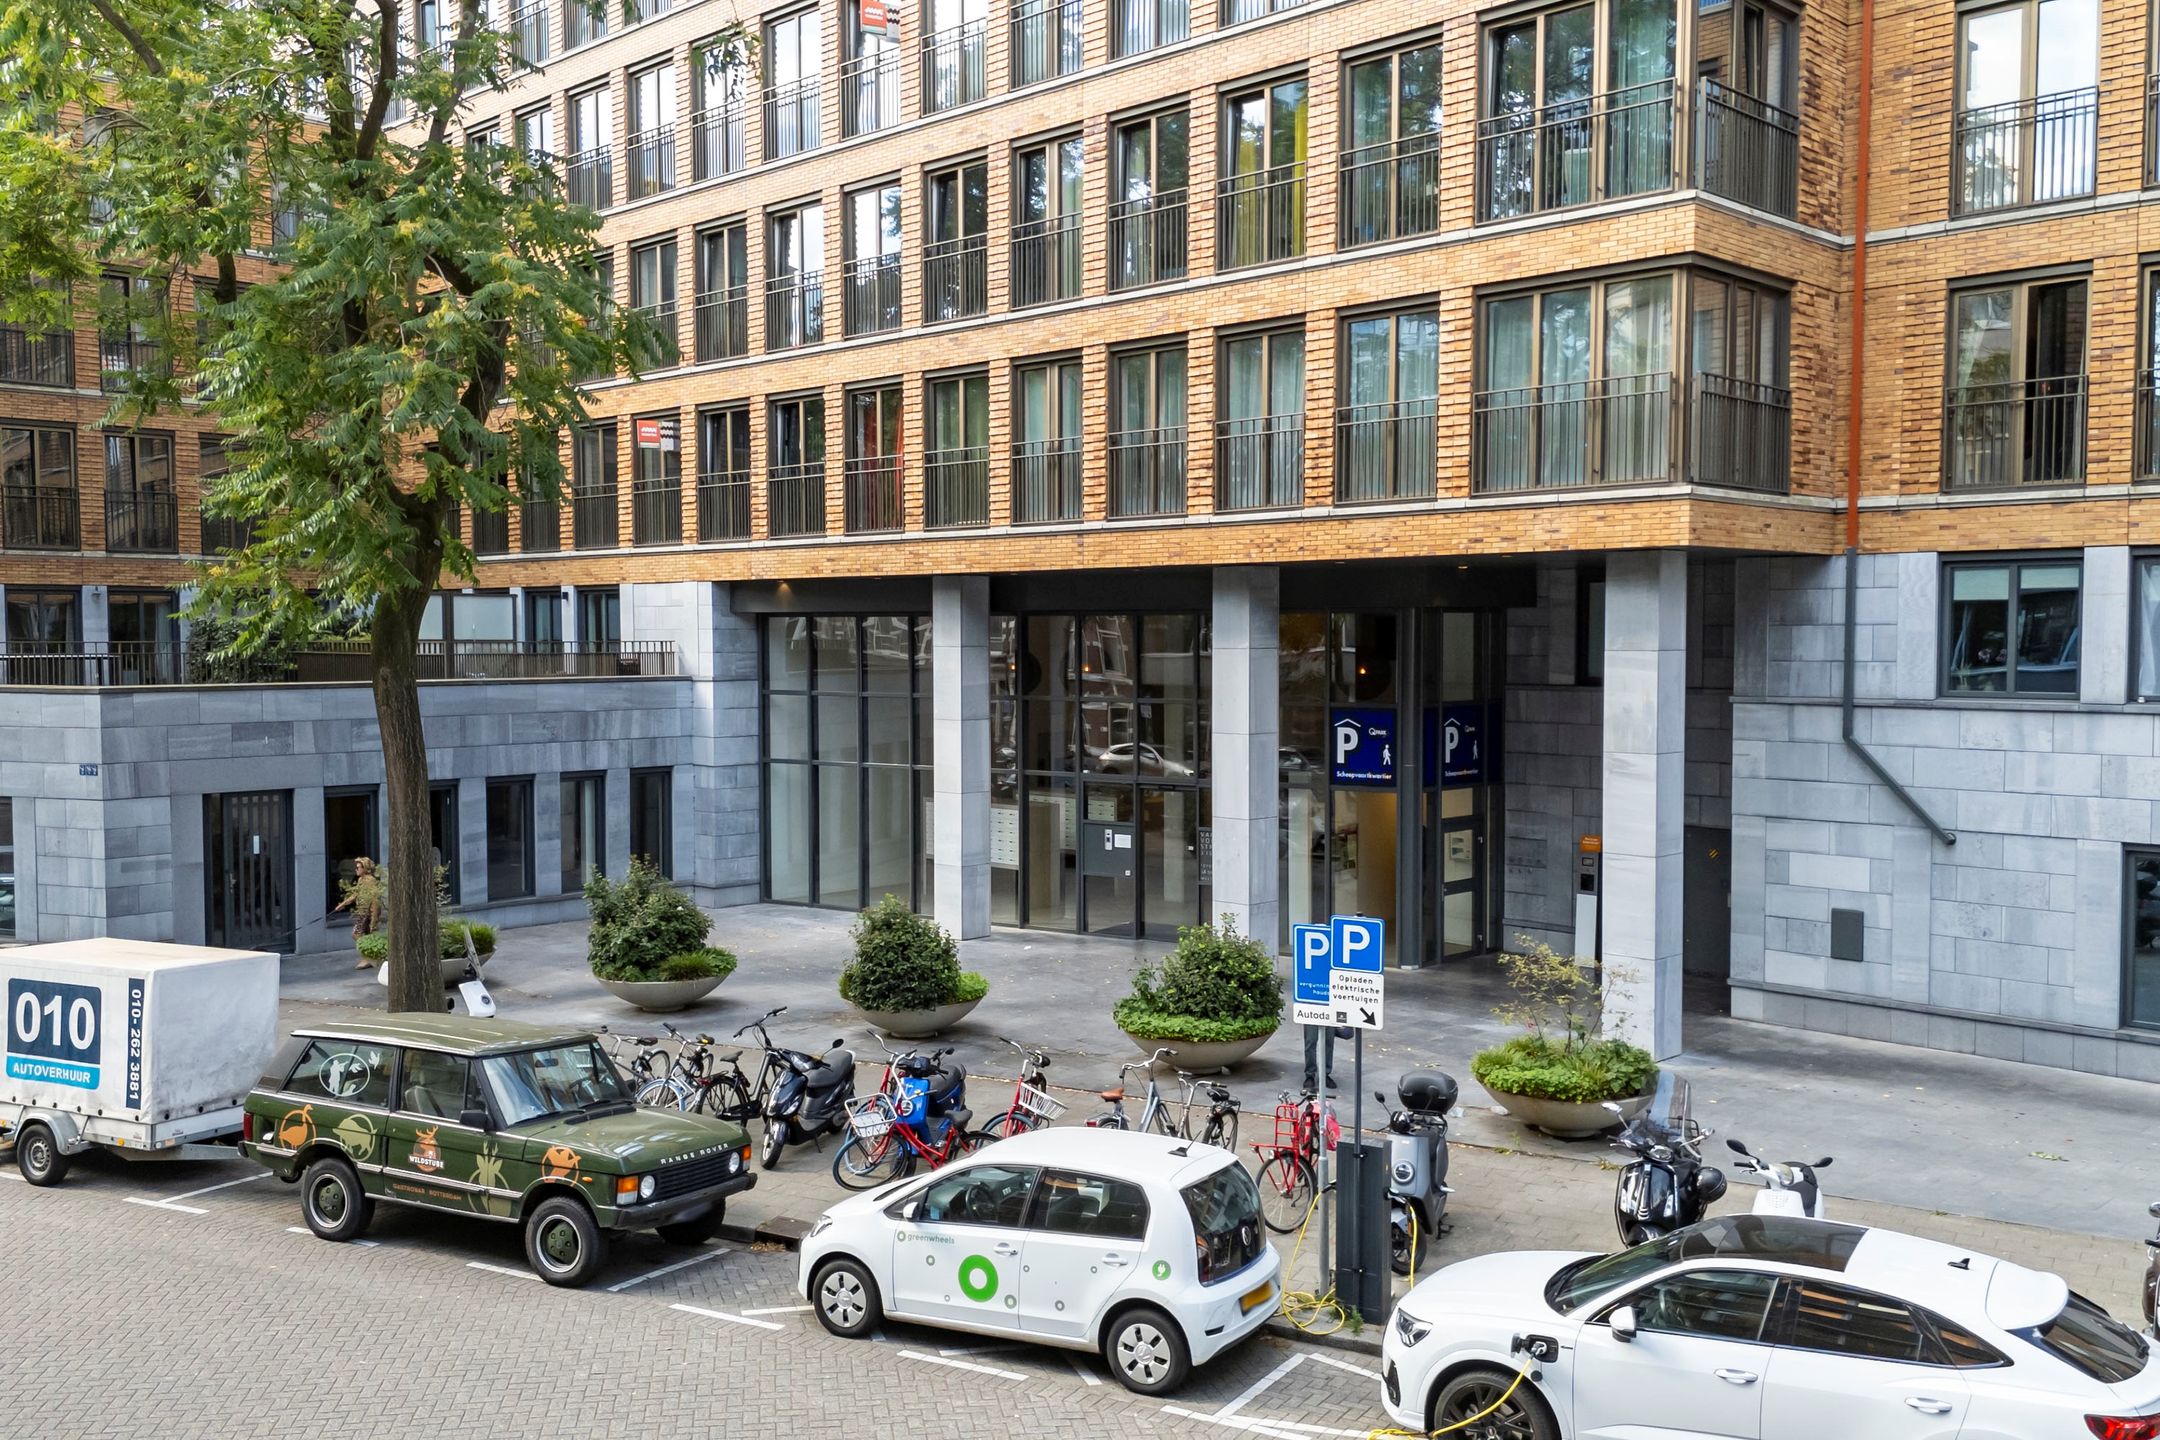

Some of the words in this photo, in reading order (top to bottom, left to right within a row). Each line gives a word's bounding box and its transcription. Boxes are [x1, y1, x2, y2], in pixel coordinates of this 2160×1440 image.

[1337, 727, 1358, 763] P
[1445, 726, 1459, 763] P
[1305, 932, 1330, 969] P
[1343, 924, 1370, 964] P
[1332, 984, 1380, 995] elektrische
[1339, 975, 1373, 985] Opladen
[1333, 993, 1379, 1004] voertuigen
[16, 991, 95, 1050] 010
[130, 1028, 141, 1058] 262
[13, 1062, 91, 1083] AUTOVERHUUR
[129, 1062, 140, 1100] 3881
[660, 1151, 695, 1165] RANGE
[700, 1143, 729, 1155] ROVER
[907, 1234, 955, 1244] greenwheels
